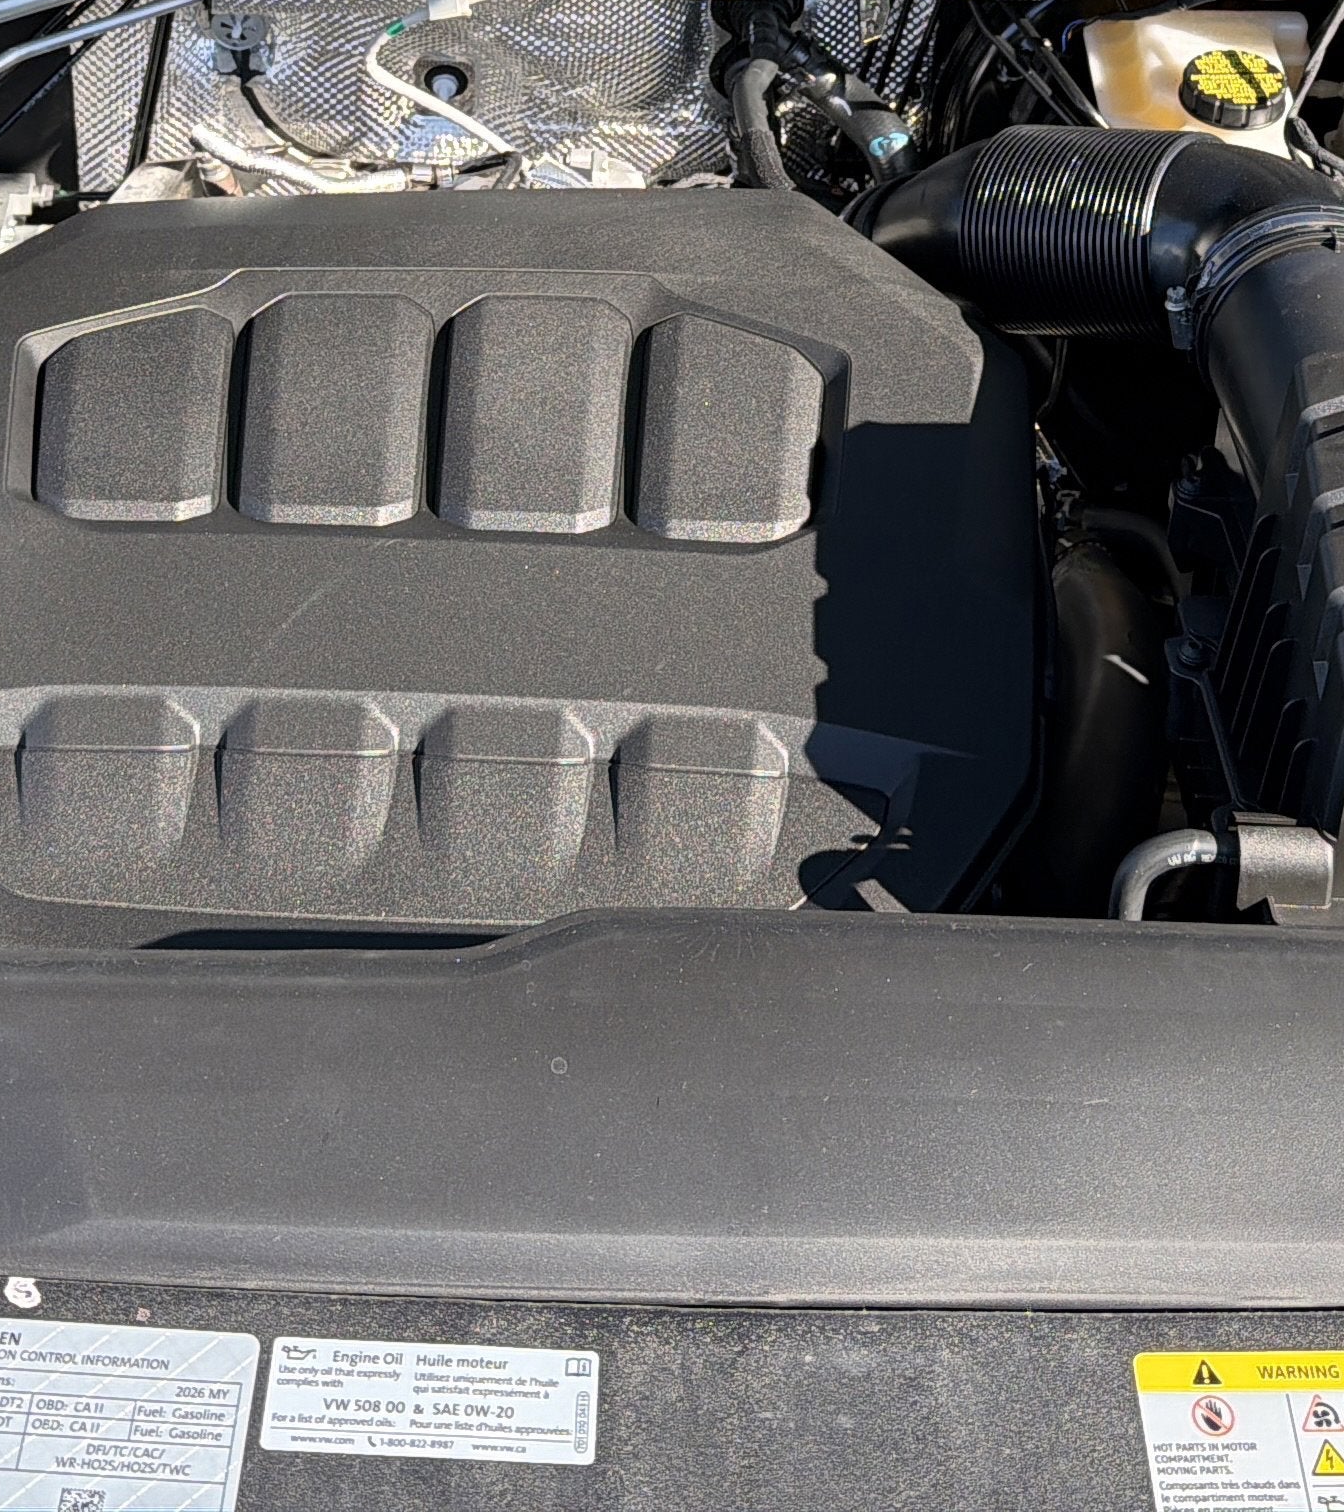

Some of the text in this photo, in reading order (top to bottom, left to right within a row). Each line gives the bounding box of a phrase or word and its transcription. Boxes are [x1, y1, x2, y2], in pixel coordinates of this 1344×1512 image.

[19, 1350, 79, 1365] CONTROL
[81, 1354, 170, 1371] INFORMATION
[332, 1350, 403, 1368] Engine Oil
[415, 1354, 509, 1371] Huile moteur
[278, 1364, 402, 1382] Use only oil that expressly
[414, 1372, 560, 1388] Utilisez uniquement de l'huile
[1255, 1364, 1340, 1380] WARNING
[276, 1377, 344, 1389] complies with
[175, 1386, 206, 1399] 2026
[208, 1388, 230, 1401] MY
[413, 1384, 430, 1396] qui
[431, 1385, 470, 1396] satisfait
[472, 1388, 541, 1400] expressément
[35, 1398, 68, 1411] OBD:
[73, 1400, 92, 1413] CA
[137, 1404, 167, 1419] Fuel:
[171, 1407, 226, 1422] Gasoline
[323, 1397, 515, 1419] VW 508 00 & SAE 0W-20
[271, 1412, 288, 1423] For
[297, 1413, 313, 1424] list
[314, 1414, 325, 1424] of
[327, 1415, 374, 1428] approved
[409, 1418, 432, 1430] Pour
[433, 1420, 453, 1430] une
[455, 1420, 474, 1431] liste
[475, 1421, 513, 1433] d'huiles
[31, 1417, 64, 1431] OBD:
[69, 1420, 88, 1432] CA
[133, 1424, 164, 1438] Fuel:
[168, 1427, 223, 1442] Gasoline
[85, 1443, 166, 1460] DFI/TC/CAC/
[291, 1435, 355, 1445] www.vw.com
[471, 1443, 527, 1453] www.vw.ca
[1153, 1442, 1257, 1453] HOT PARTS IN MOTOR
[55, 1455, 192, 1477] WR-HO2S/HO2S/TWC
[1155, 1454, 1233, 1464] COMPARTMENT.
[1157, 1465, 1234, 1476] MOVING PARTS.
[1159, 1480, 1301, 1493] Composants très chauds dans
[1161, 1493, 1289, 1505] le compartiment moteur.
